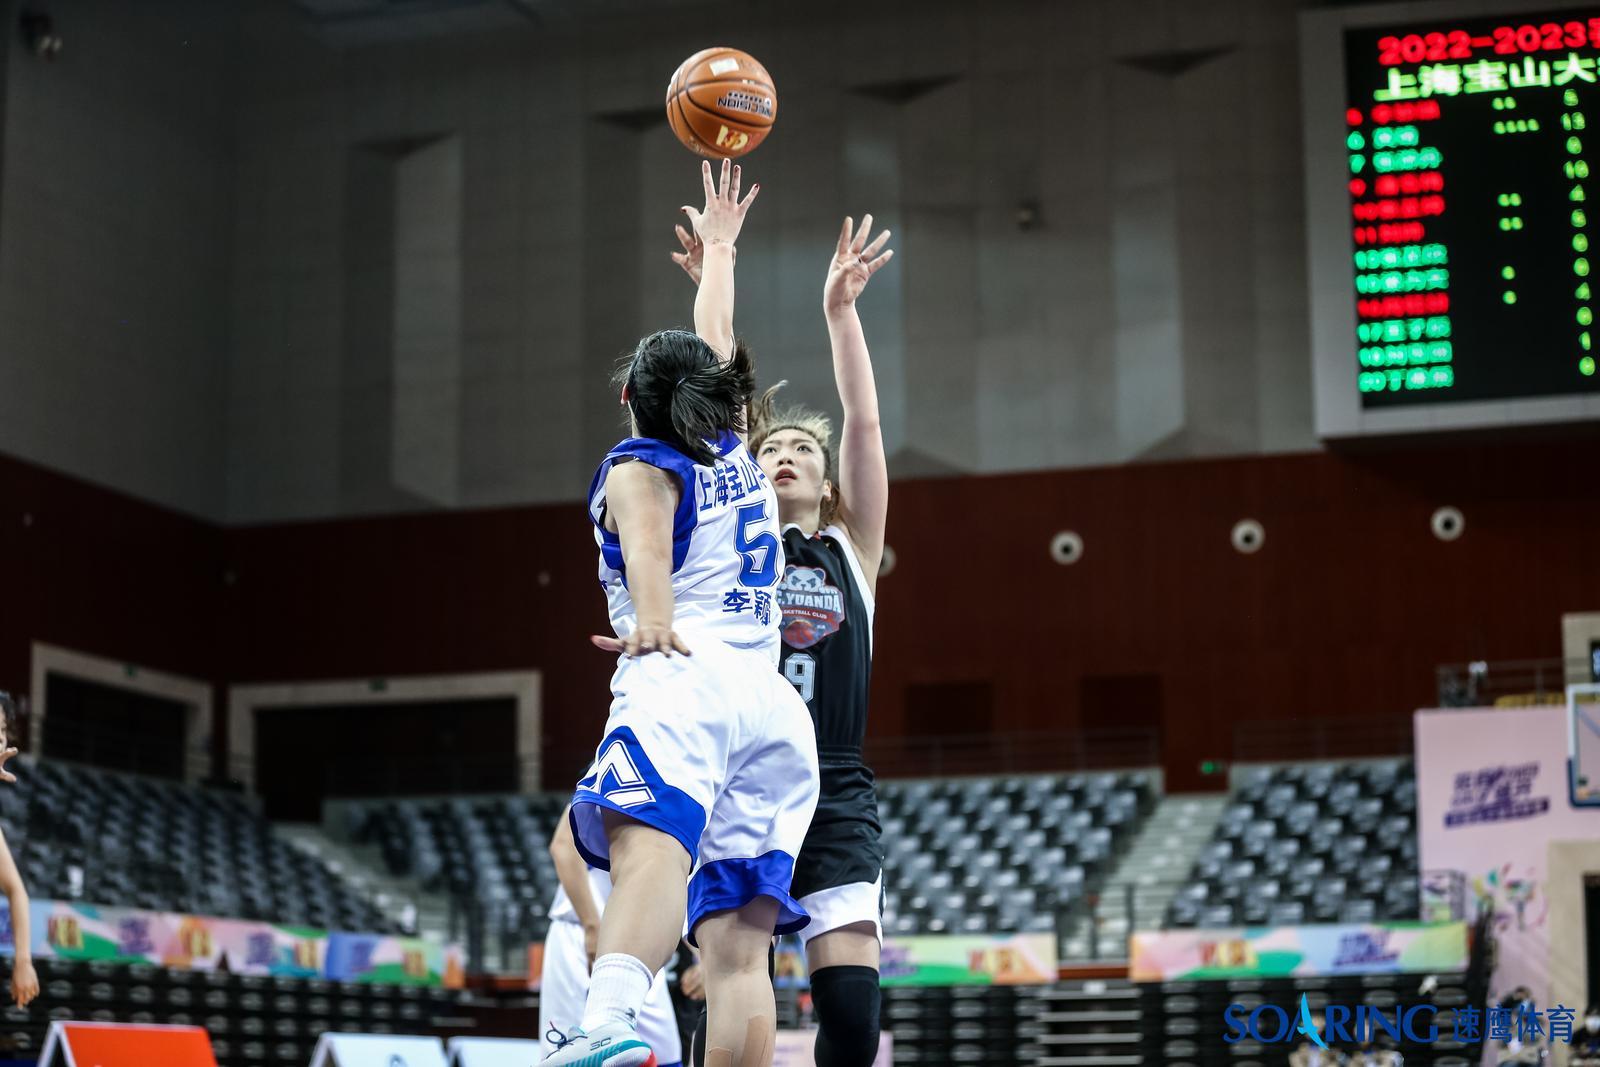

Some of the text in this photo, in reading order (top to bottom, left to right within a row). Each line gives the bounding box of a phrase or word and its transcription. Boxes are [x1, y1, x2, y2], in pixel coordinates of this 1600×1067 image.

[1373, 51, 1600, 102] 上海宝山大
[699, 456, 767, 511] 上海宝山
[733, 500, 781, 587] 5
[782, 609, 811, 617] SKETBALL
[785, 653, 816, 704] 9
